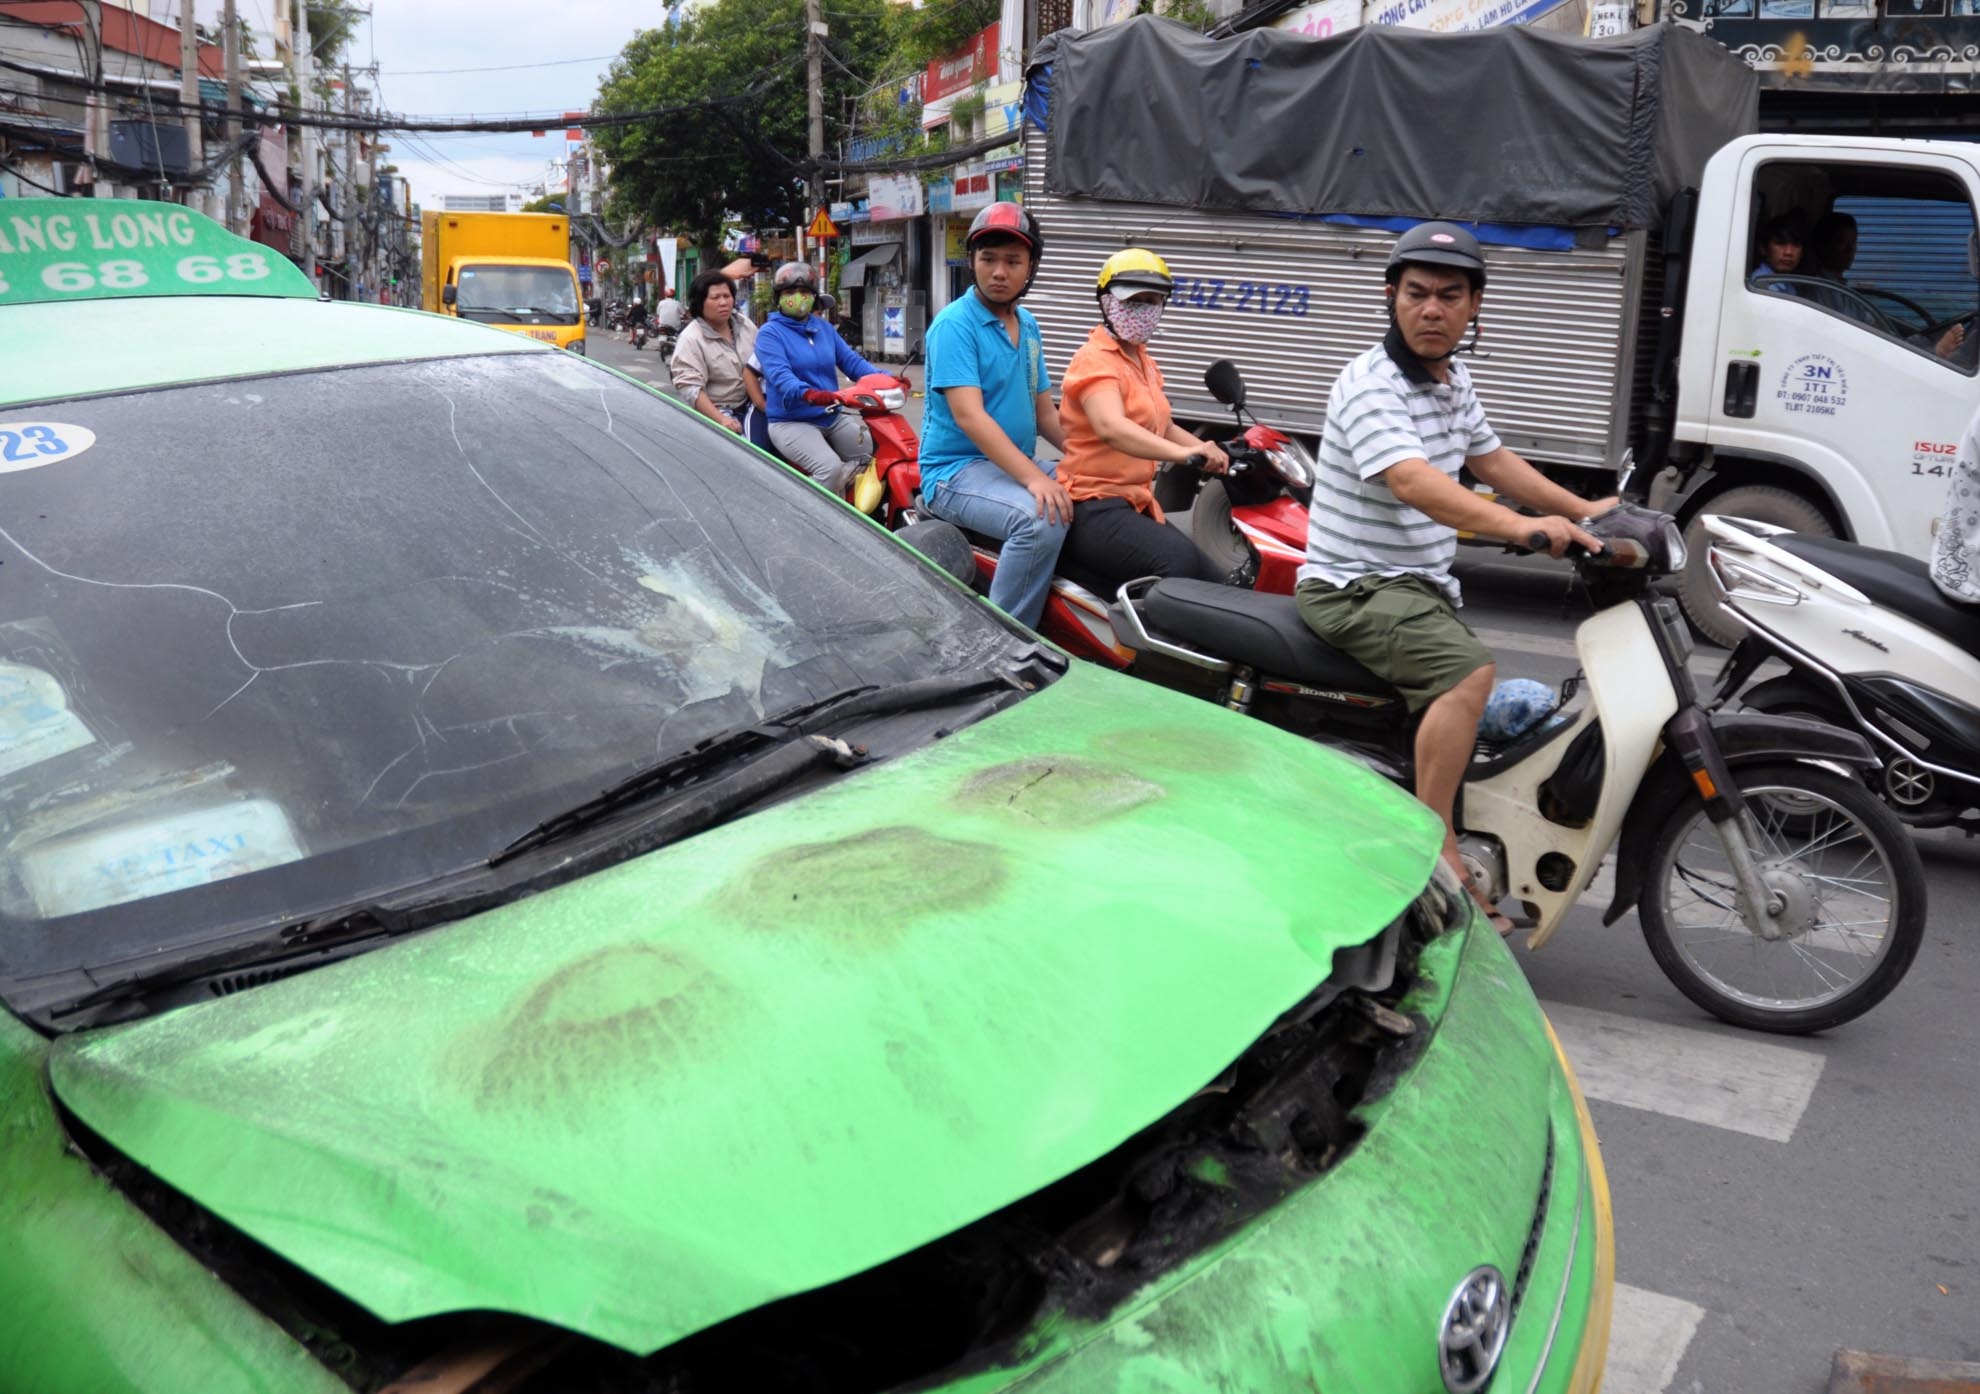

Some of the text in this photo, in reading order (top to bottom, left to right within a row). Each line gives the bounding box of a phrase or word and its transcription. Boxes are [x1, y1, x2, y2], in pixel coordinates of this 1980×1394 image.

[85, 212, 195, 250] LONG
[41, 260, 149, 292] 68
[176, 252, 271, 284] 68
[1803, 364, 1832, 379] 3N
[0, 425, 69, 462] 23
[1914, 442, 1957, 455] ISUZ
[1299, 687, 1346, 701] HONDA
